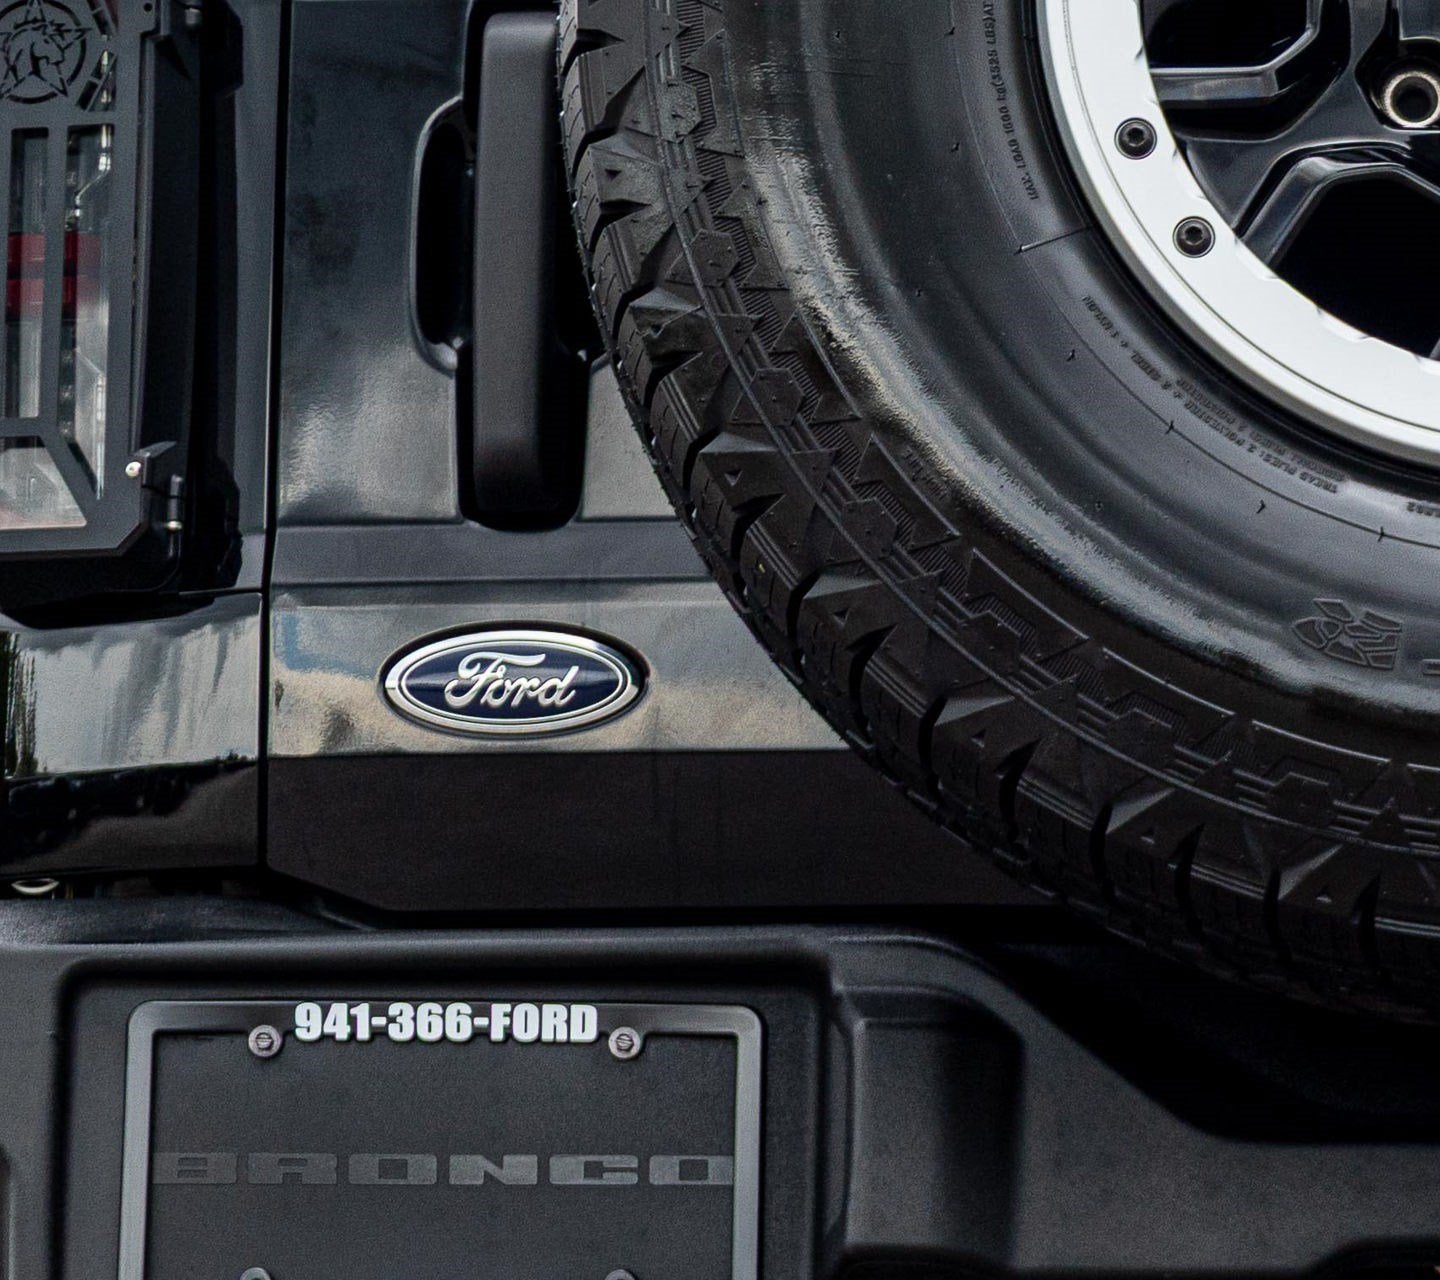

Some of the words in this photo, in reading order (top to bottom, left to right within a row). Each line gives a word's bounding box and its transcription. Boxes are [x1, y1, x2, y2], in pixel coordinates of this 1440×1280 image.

[444, 651, 579, 710] Ford
[295, 1001, 599, 1042] 941-366-FORD
[154, 1152, 733, 1186] BRONCO
